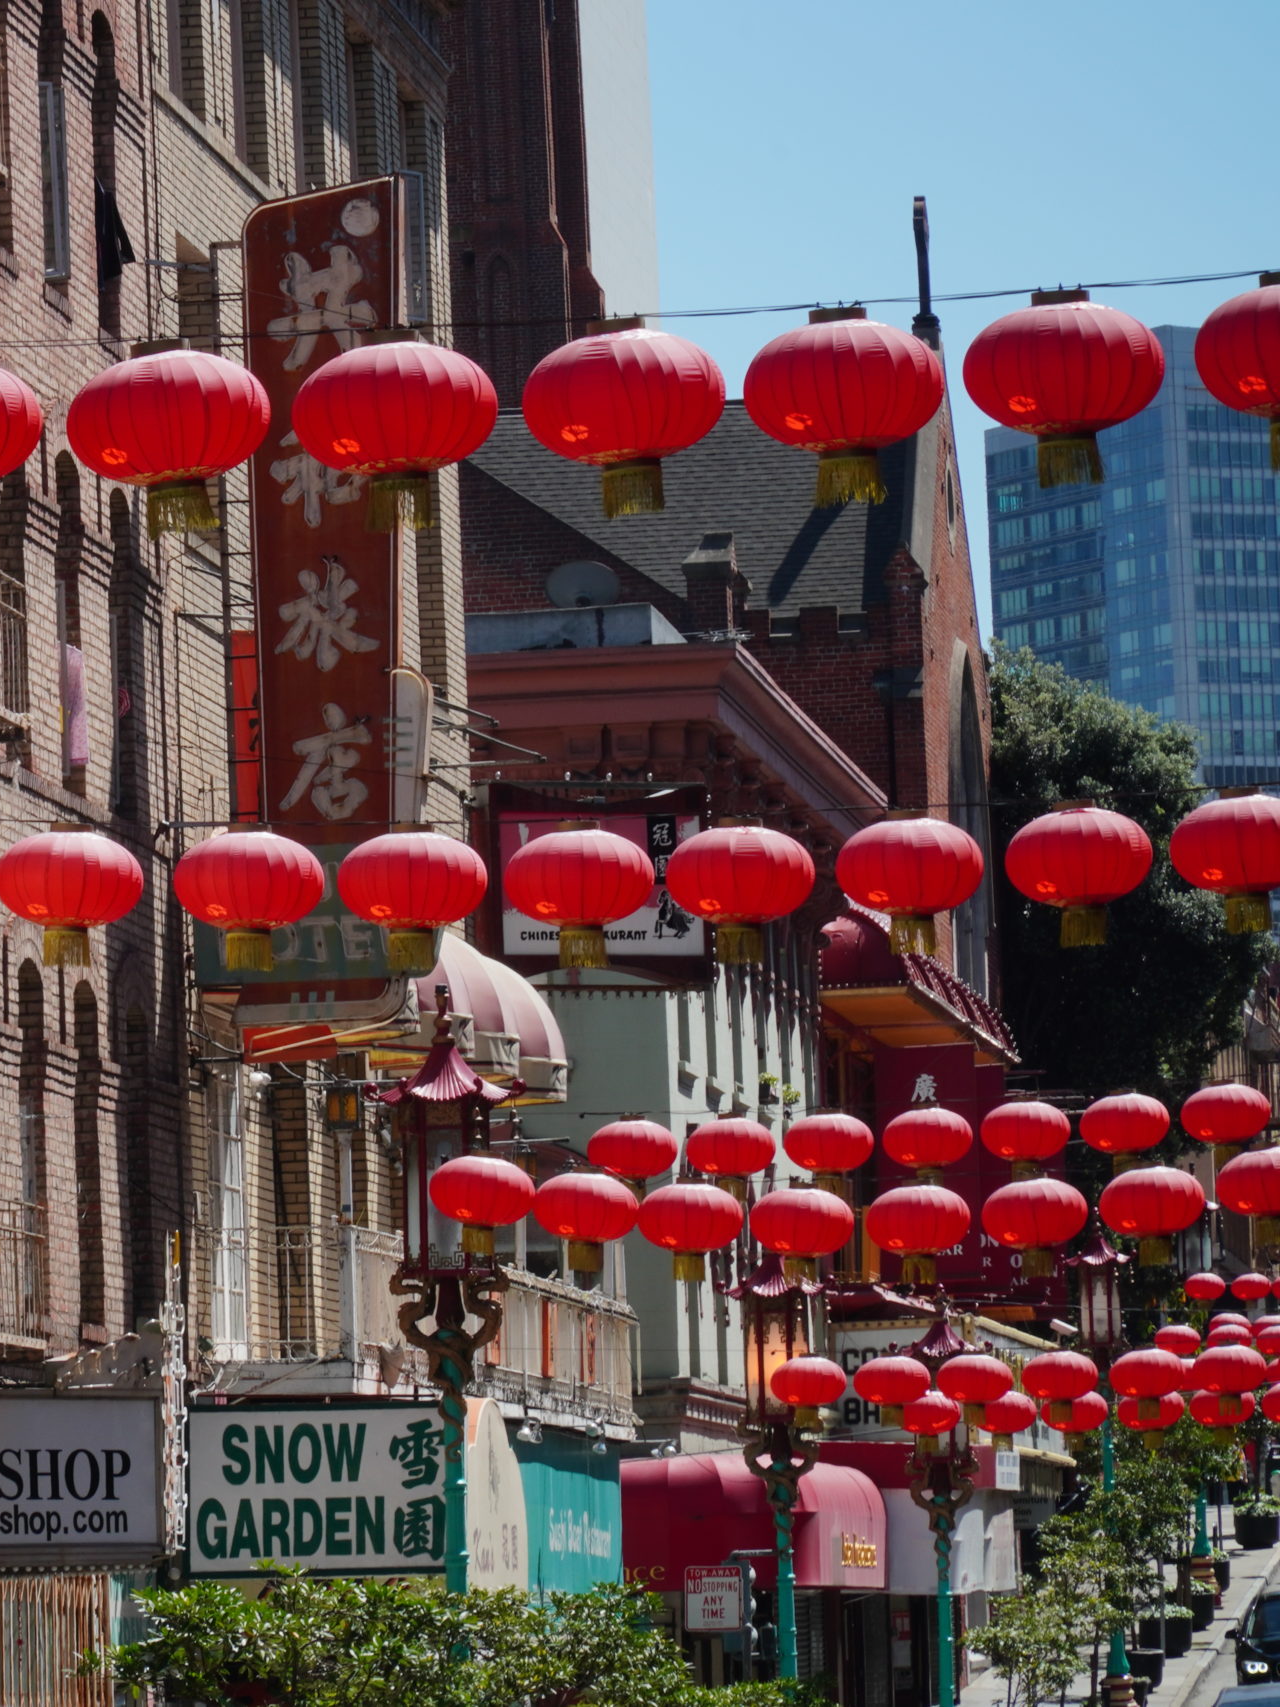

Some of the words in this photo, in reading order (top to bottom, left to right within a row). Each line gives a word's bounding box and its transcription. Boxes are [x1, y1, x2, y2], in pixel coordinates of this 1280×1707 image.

[219, 913, 389, 966] OTE
[521, 930, 560, 941] CHINES
[222, 1423, 366, 1486] SNOW
[196, 1496, 385, 1560] GARDEN
[689, 1568, 737, 1577] TOW-AWAY
[688, 1579, 701, 1593] NO
[703, 1582, 737, 1592] STOPPING
[703, 1596, 723, 1605] ANY
[701, 1608, 725, 1619] TIME
